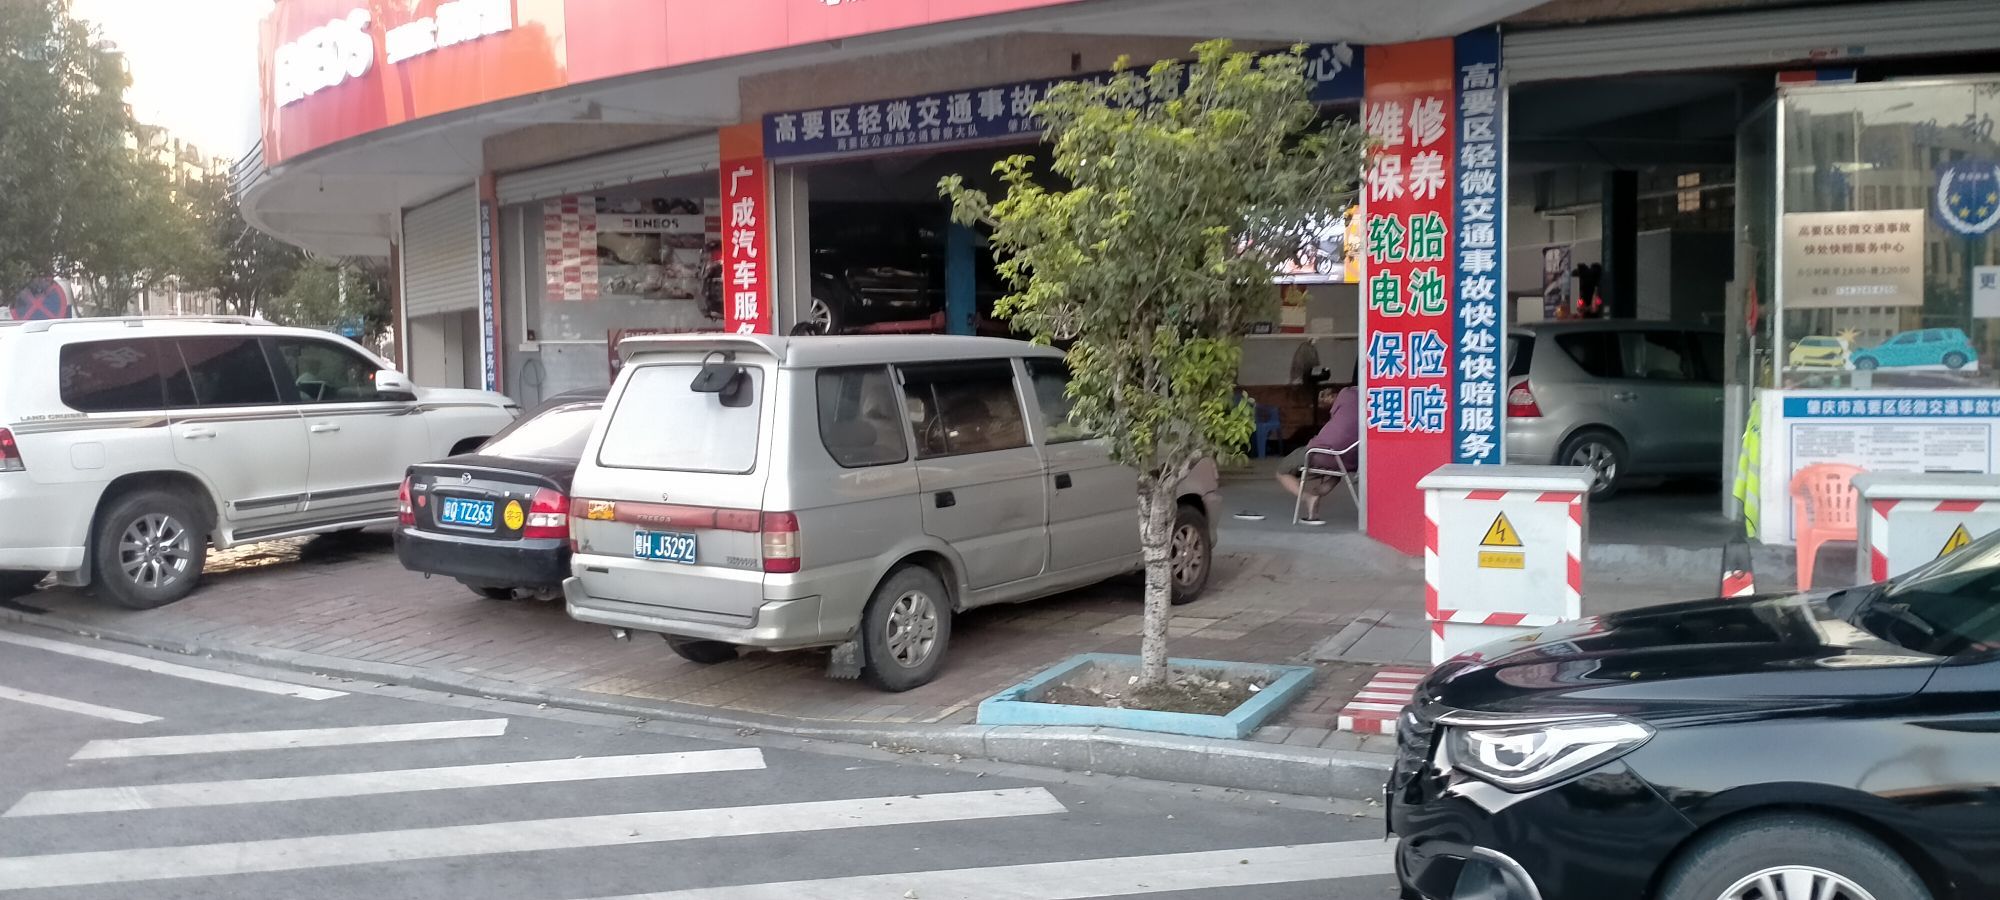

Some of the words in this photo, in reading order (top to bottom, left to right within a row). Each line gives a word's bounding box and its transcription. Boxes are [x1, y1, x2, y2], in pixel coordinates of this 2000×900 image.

[1367, 96, 1448, 150] 维修
[1367, 150, 1448, 203] 保养
[634, 217, 680, 229] ENEOS
[1368, 210, 1449, 265] 轮胎
[1797, 221, 1912, 237] 高要区轻微交通事故
[1803, 240, 1905, 256] 快处快赔服务中心
[1458, 62, 1496, 464] 高要区轻微交通事故快处快赔服务
[481, 205, 495, 391] 交通事故快处快赔服务中
[1369, 268, 1449, 318] 电池
[1367, 330, 1448, 381] 保险
[47, 412, 89, 420] CRUISER
[1367, 384, 1448, 433] 理赔
